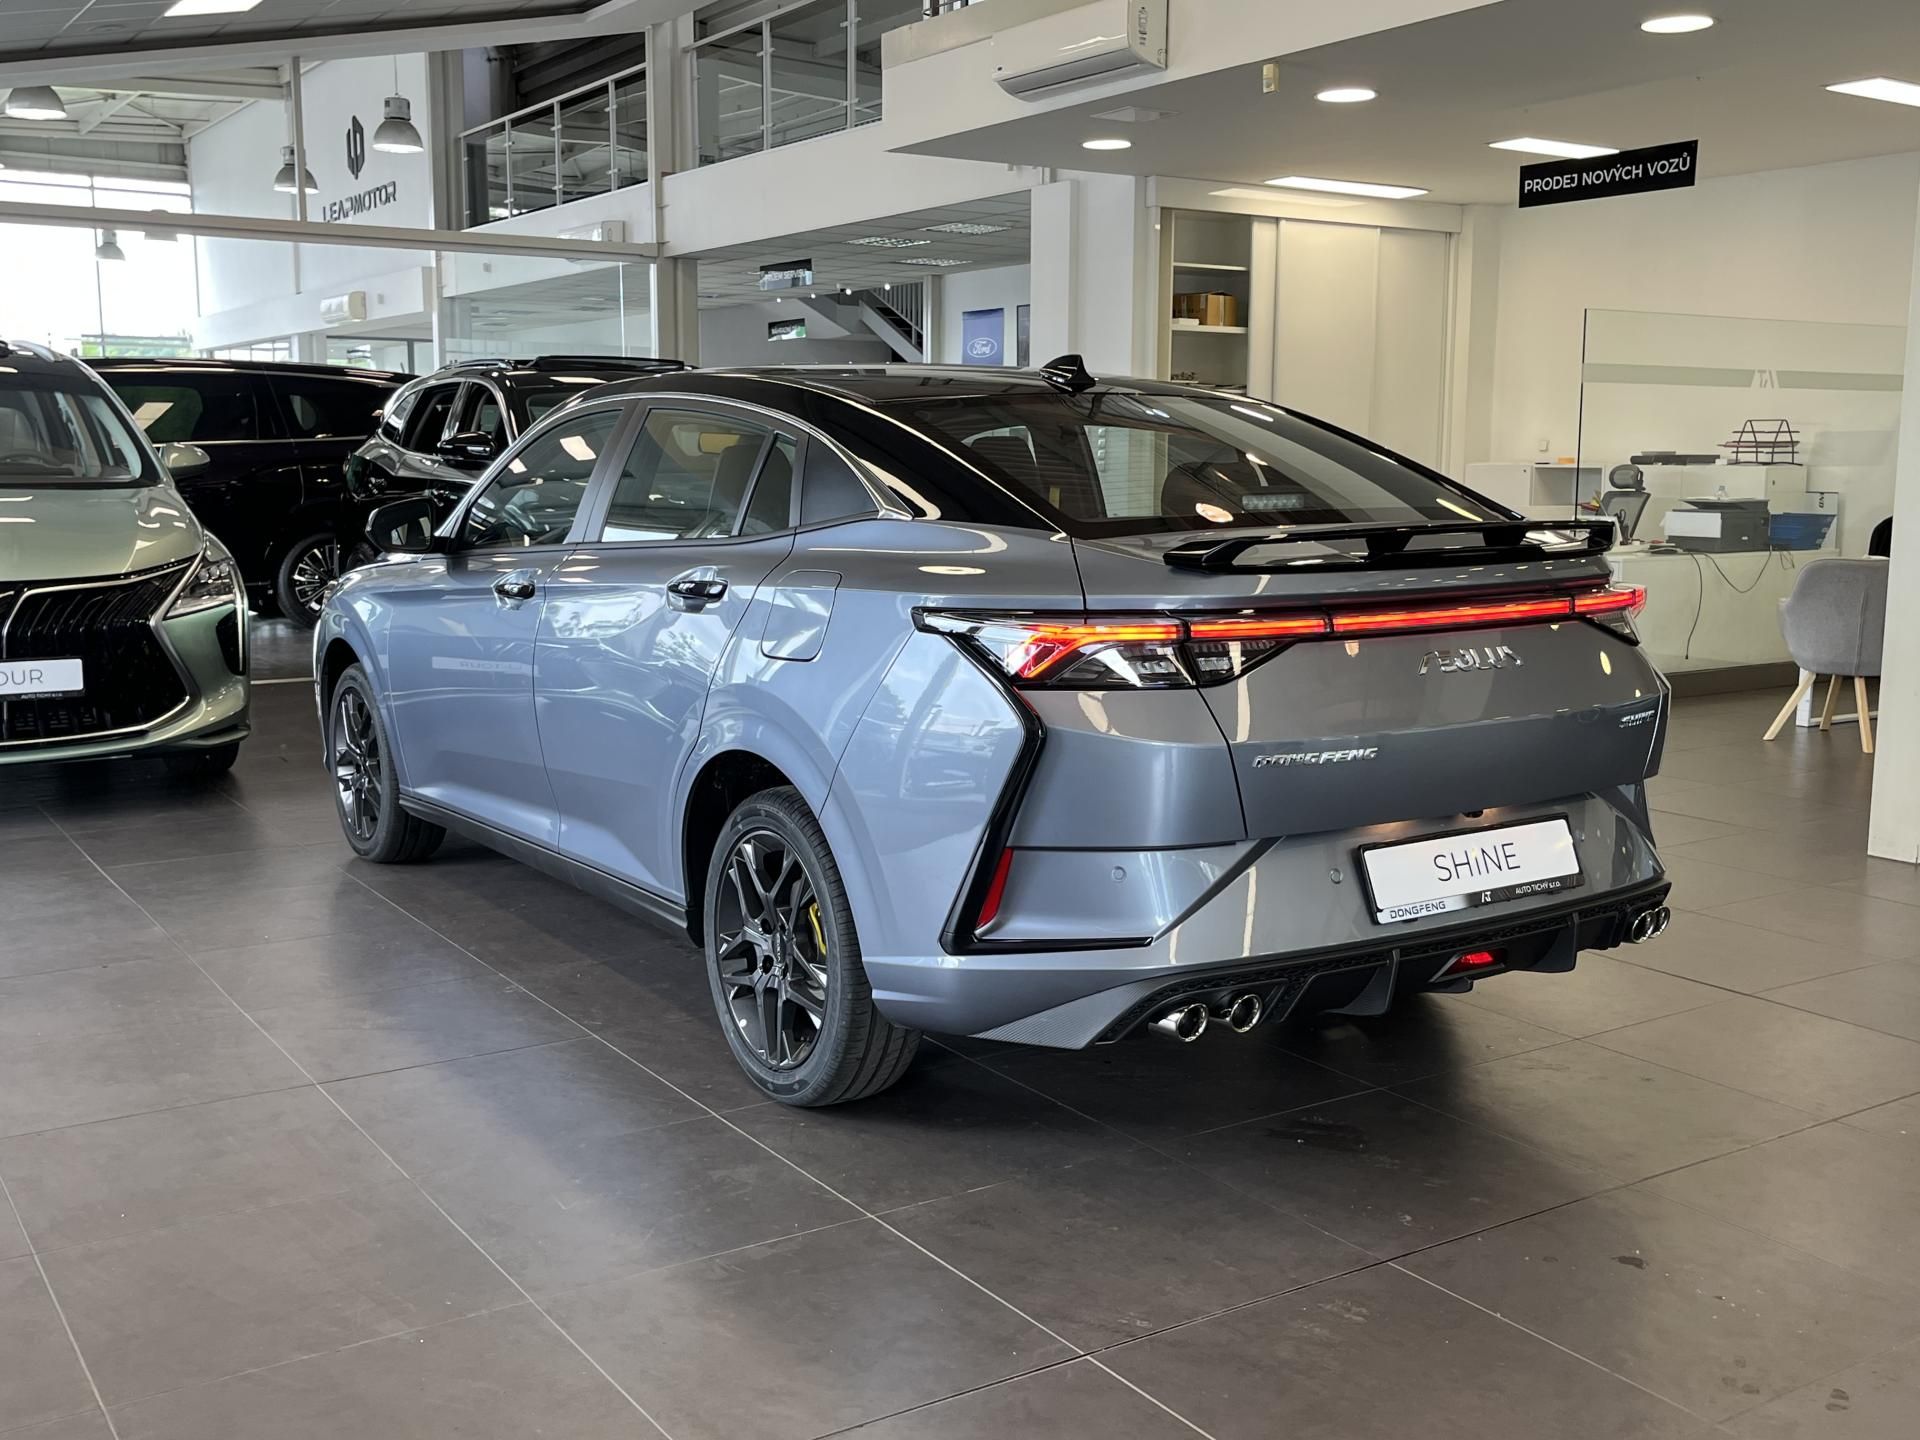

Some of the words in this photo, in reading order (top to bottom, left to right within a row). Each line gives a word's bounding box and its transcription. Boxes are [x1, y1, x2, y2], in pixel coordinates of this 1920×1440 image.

[1523, 173, 1578, 194] PRODEJ
[1581, 163, 1643, 186] NOVÝCH
[1646, 152, 1691, 177] VOZŮ
[322, 181, 397, 222] LEAPMOTOR
[972, 340, 992, 355] Ford
[1252, 747, 1378, 768] DONGFENG
[1433, 842, 1521, 882] SHINE
[1515, 885, 1532, 895] AUTO
[1390, 901, 1446, 919] DONGFENG
